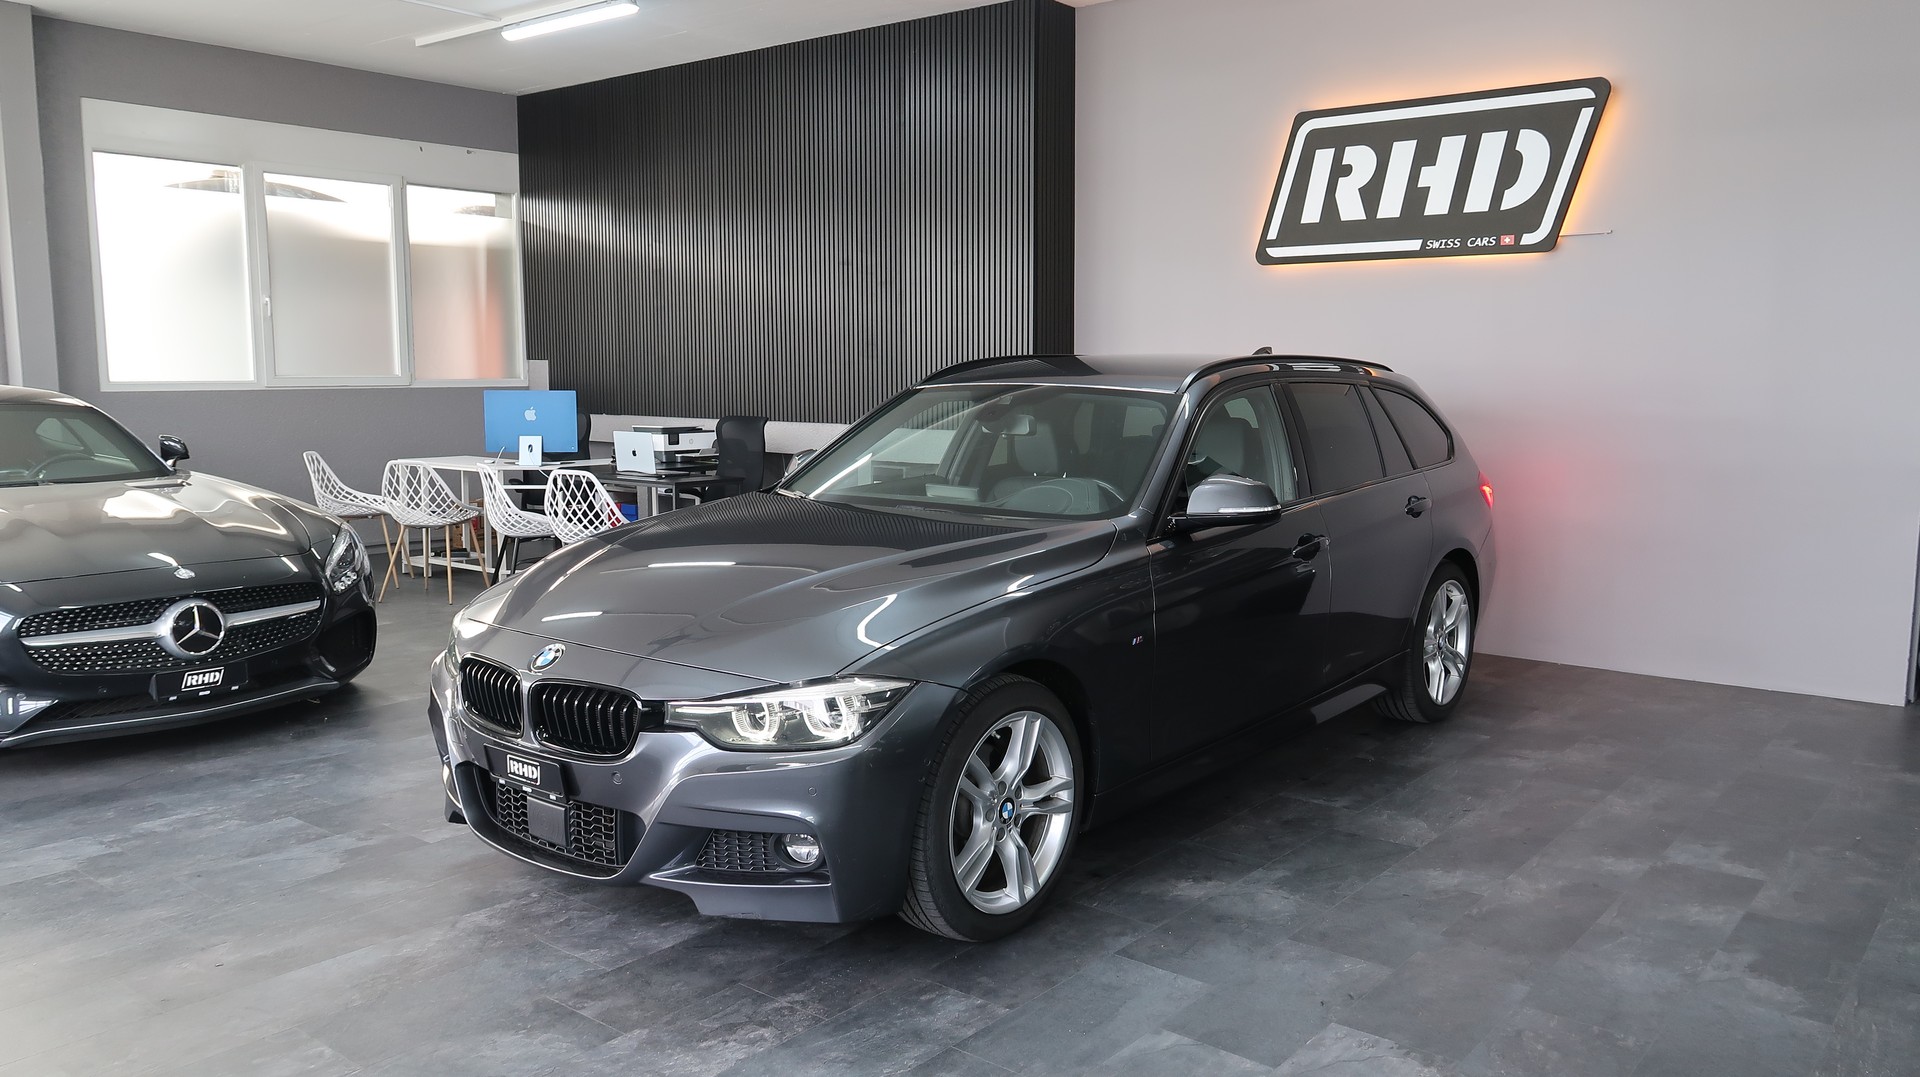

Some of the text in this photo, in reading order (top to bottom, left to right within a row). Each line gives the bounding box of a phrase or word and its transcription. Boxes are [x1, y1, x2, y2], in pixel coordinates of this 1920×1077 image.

[1300, 128, 1551, 224] RHD
[1425, 236, 1496, 249] SWISS CARS
[186, 671, 220, 686] RHD
[510, 760, 537, 779] RHD
